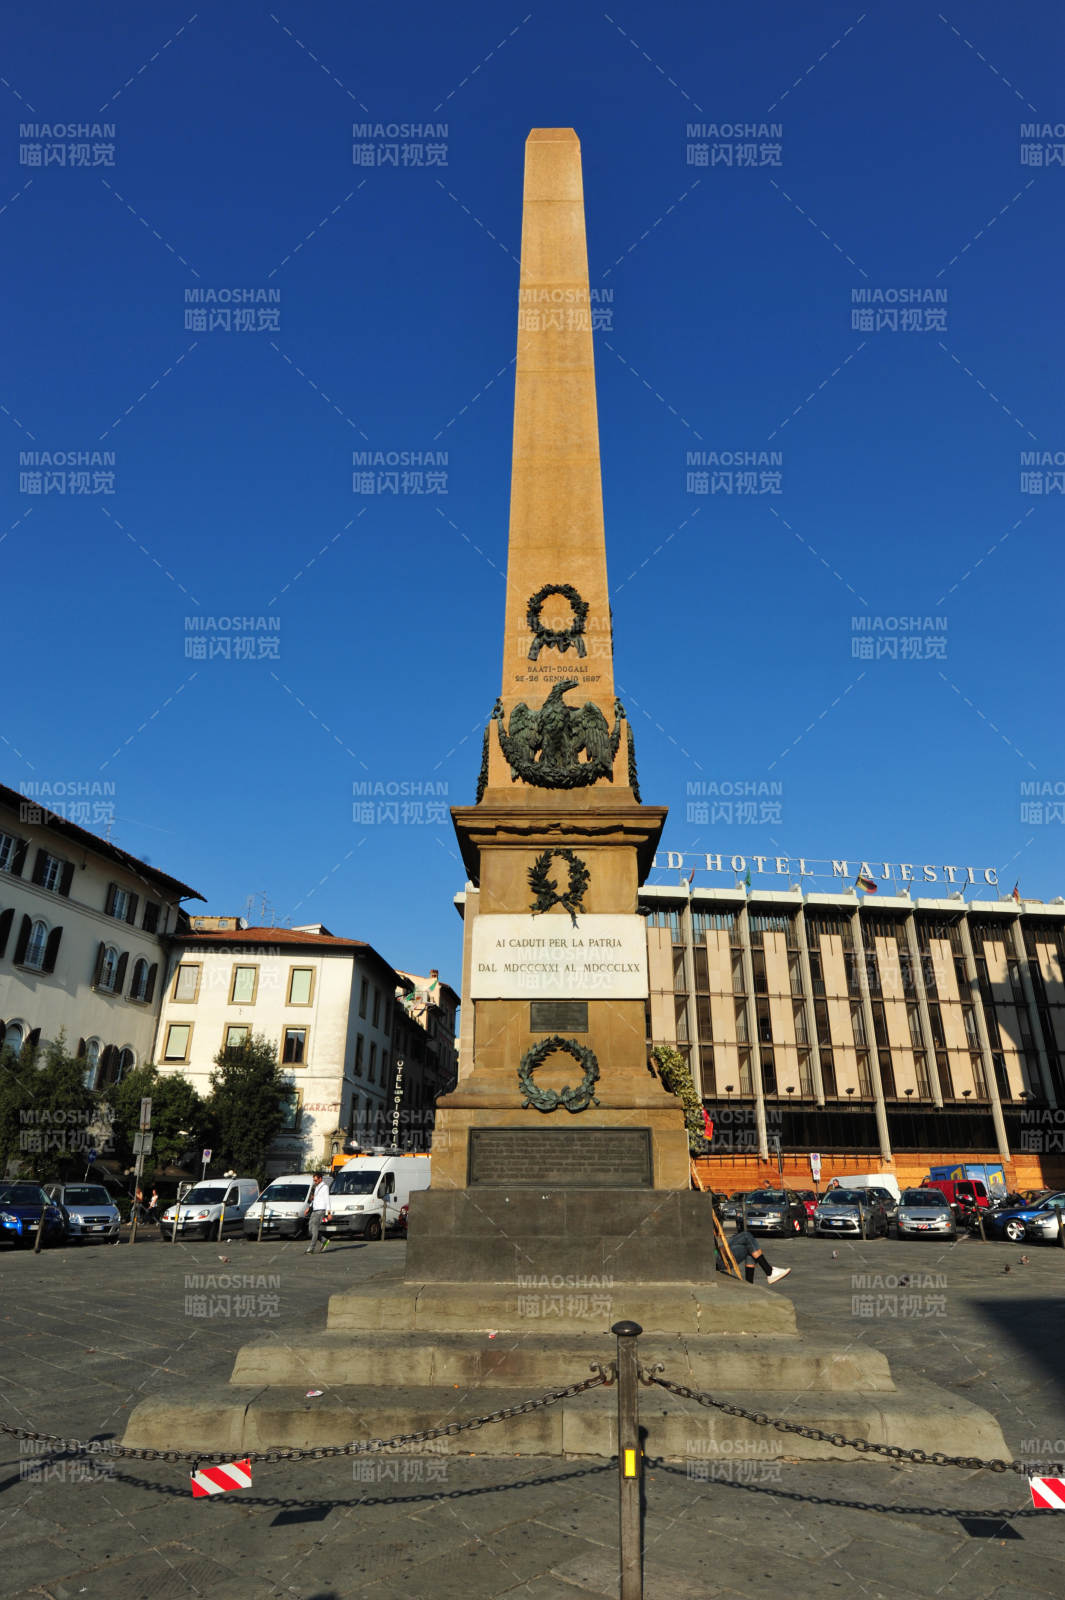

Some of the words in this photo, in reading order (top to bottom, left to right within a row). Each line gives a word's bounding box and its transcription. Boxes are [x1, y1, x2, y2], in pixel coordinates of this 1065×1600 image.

[705, 853, 814, 876] HOTEL
[832, 860, 998, 886] MAJESTIC
[496, 938, 506, 948] AI
[509, 938, 545, 948] CADUTI
[550, 938, 568, 948] PER
[572, 938, 584, 948] LA
[588, 938, 622, 948] PATRIA
[478, 963, 497, 972] DAL
[504, 963, 558, 972] MDCCCXXI
[564, 963, 576, 972] AL
[584, 963, 640, 973] MDCCCLXX
[304, 1103, 338, 1112] GARAGE
[390, 1096, 400, 1149] GIORGIO
